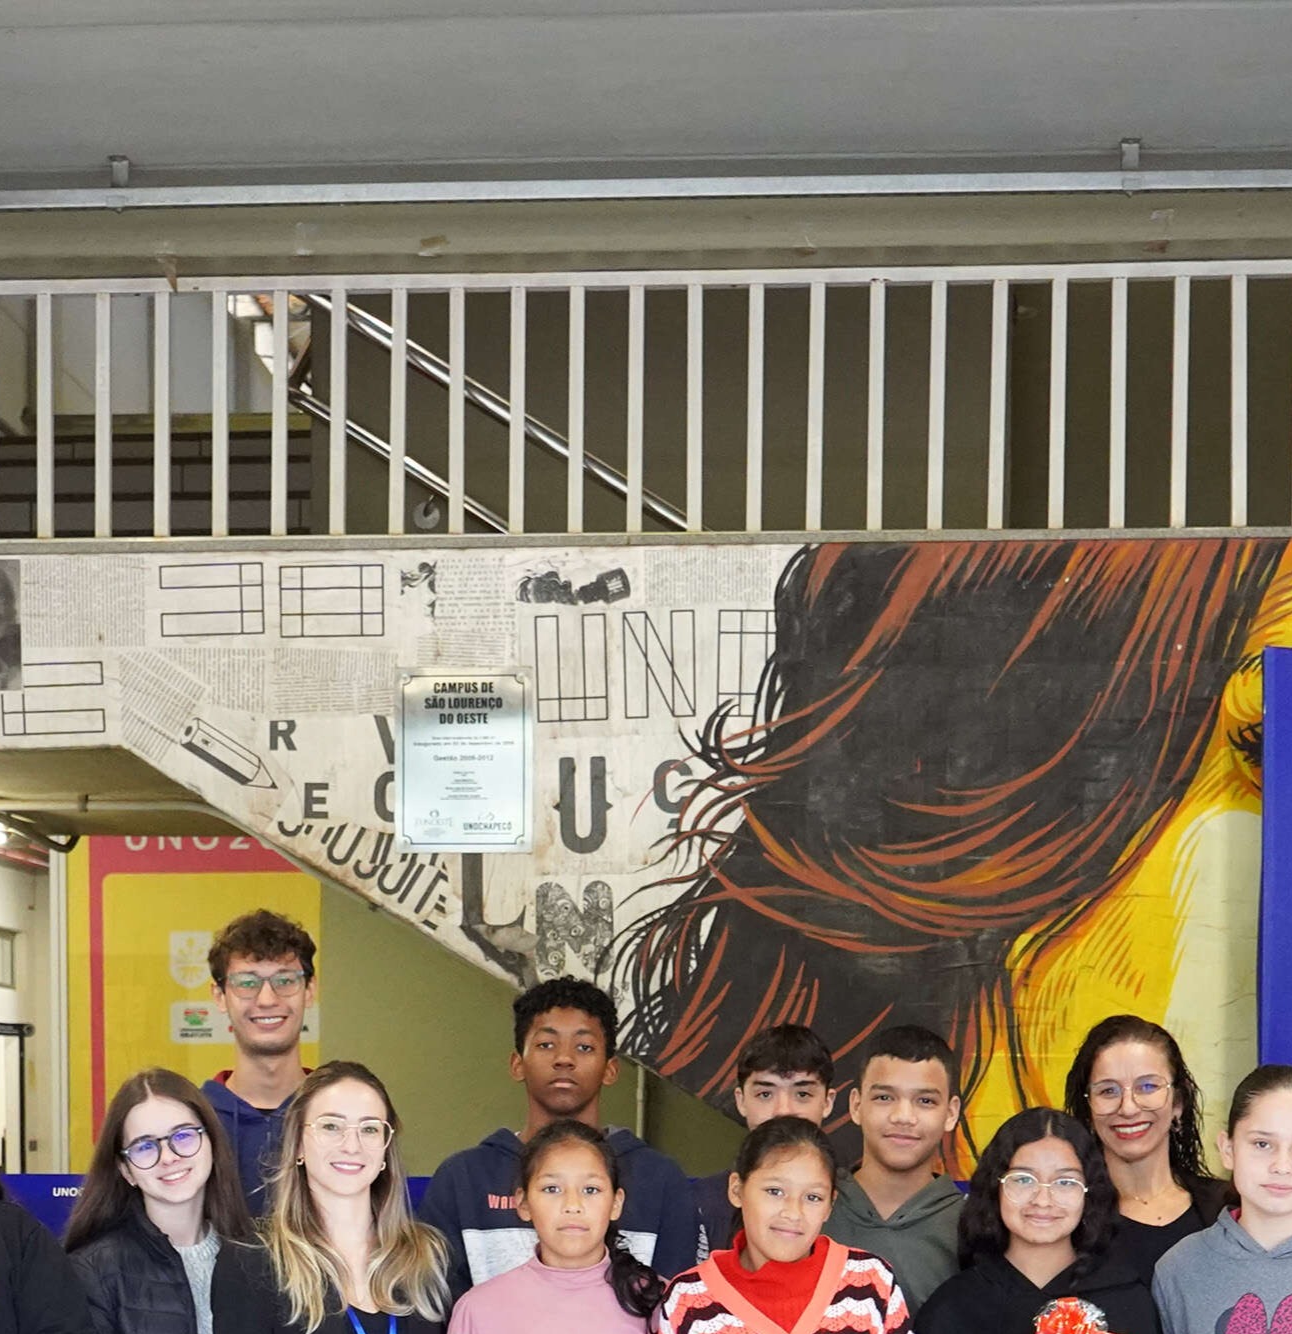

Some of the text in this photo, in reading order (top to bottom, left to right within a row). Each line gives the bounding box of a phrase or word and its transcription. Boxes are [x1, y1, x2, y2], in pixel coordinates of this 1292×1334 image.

[433, 681, 494, 694] CAMPUS DE
[424, 696, 503, 711] SÃO LOURENÇO
[439, 712, 489, 725] DO OESTE
[124, 836, 275, 851] UNO2
